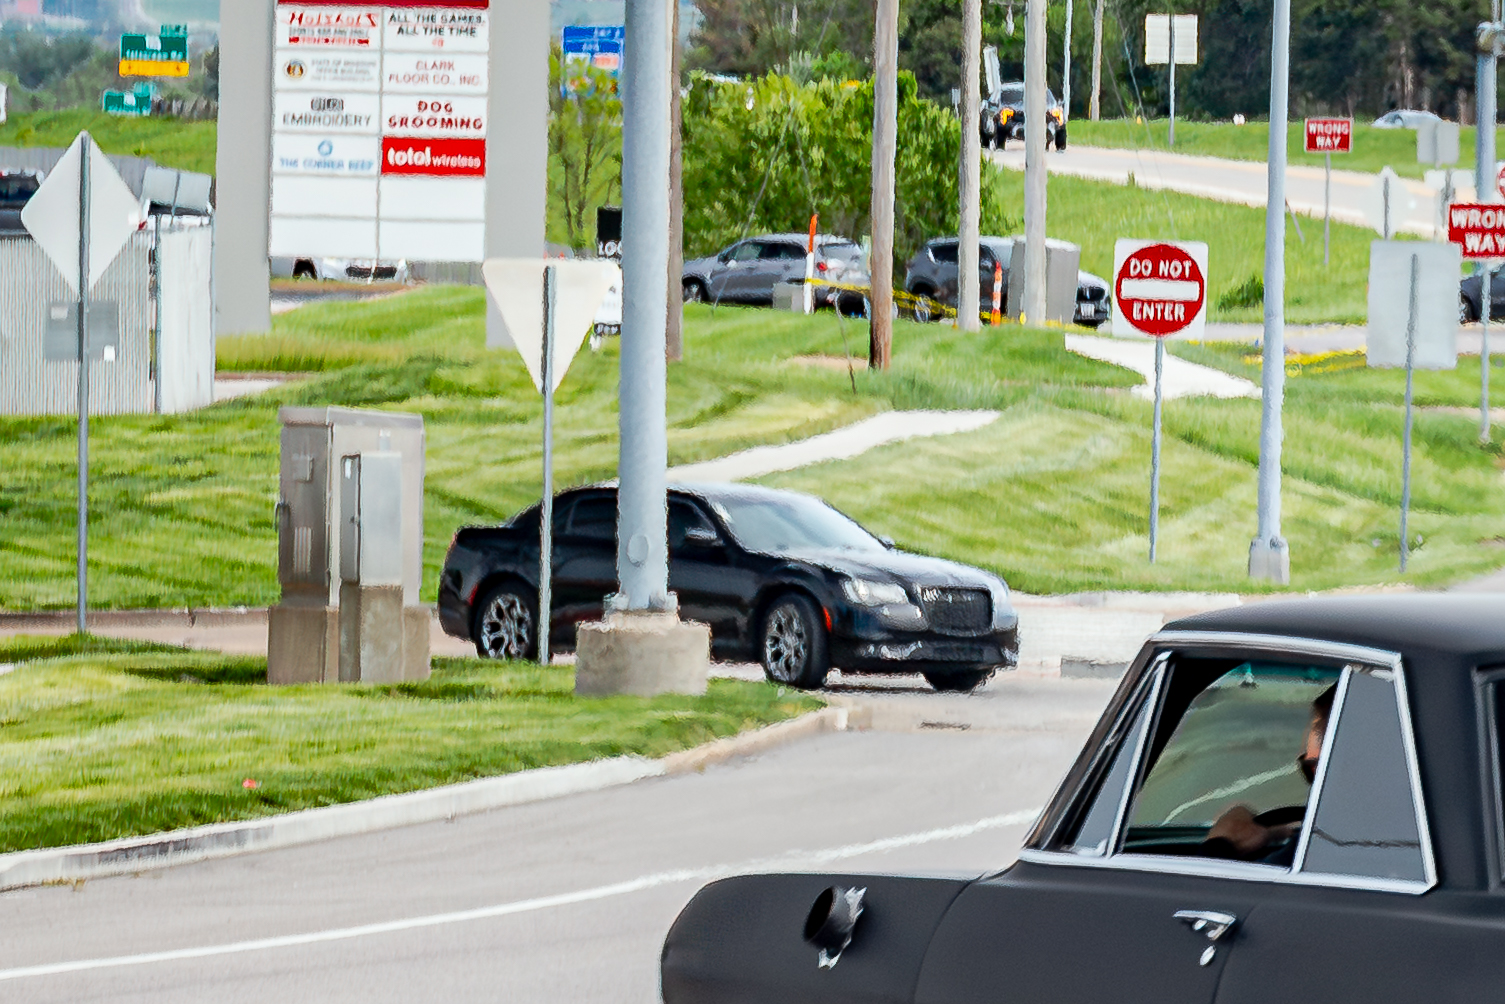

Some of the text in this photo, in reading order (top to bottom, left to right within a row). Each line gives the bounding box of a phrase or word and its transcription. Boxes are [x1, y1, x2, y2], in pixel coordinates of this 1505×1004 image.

[389, 13, 411, 23] ALL
[416, 13, 436, 24] THE
[397, 25, 477, 37] ALL THE TIME
[416, 61, 455, 71] CLARK
[388, 73, 429, 85] FLOOR
[417, 100, 453, 113] DOG
[283, 113, 371, 127] EMBROIDERY
[388, 115, 483, 130] GROOMING
[1309, 122, 1349, 135] WRONG
[1316, 136, 1341, 149] WAY
[387, 146, 481, 169] total wireless
[1129, 257, 1192, 279] DO NOT
[1132, 301, 1185, 322] ENTER
